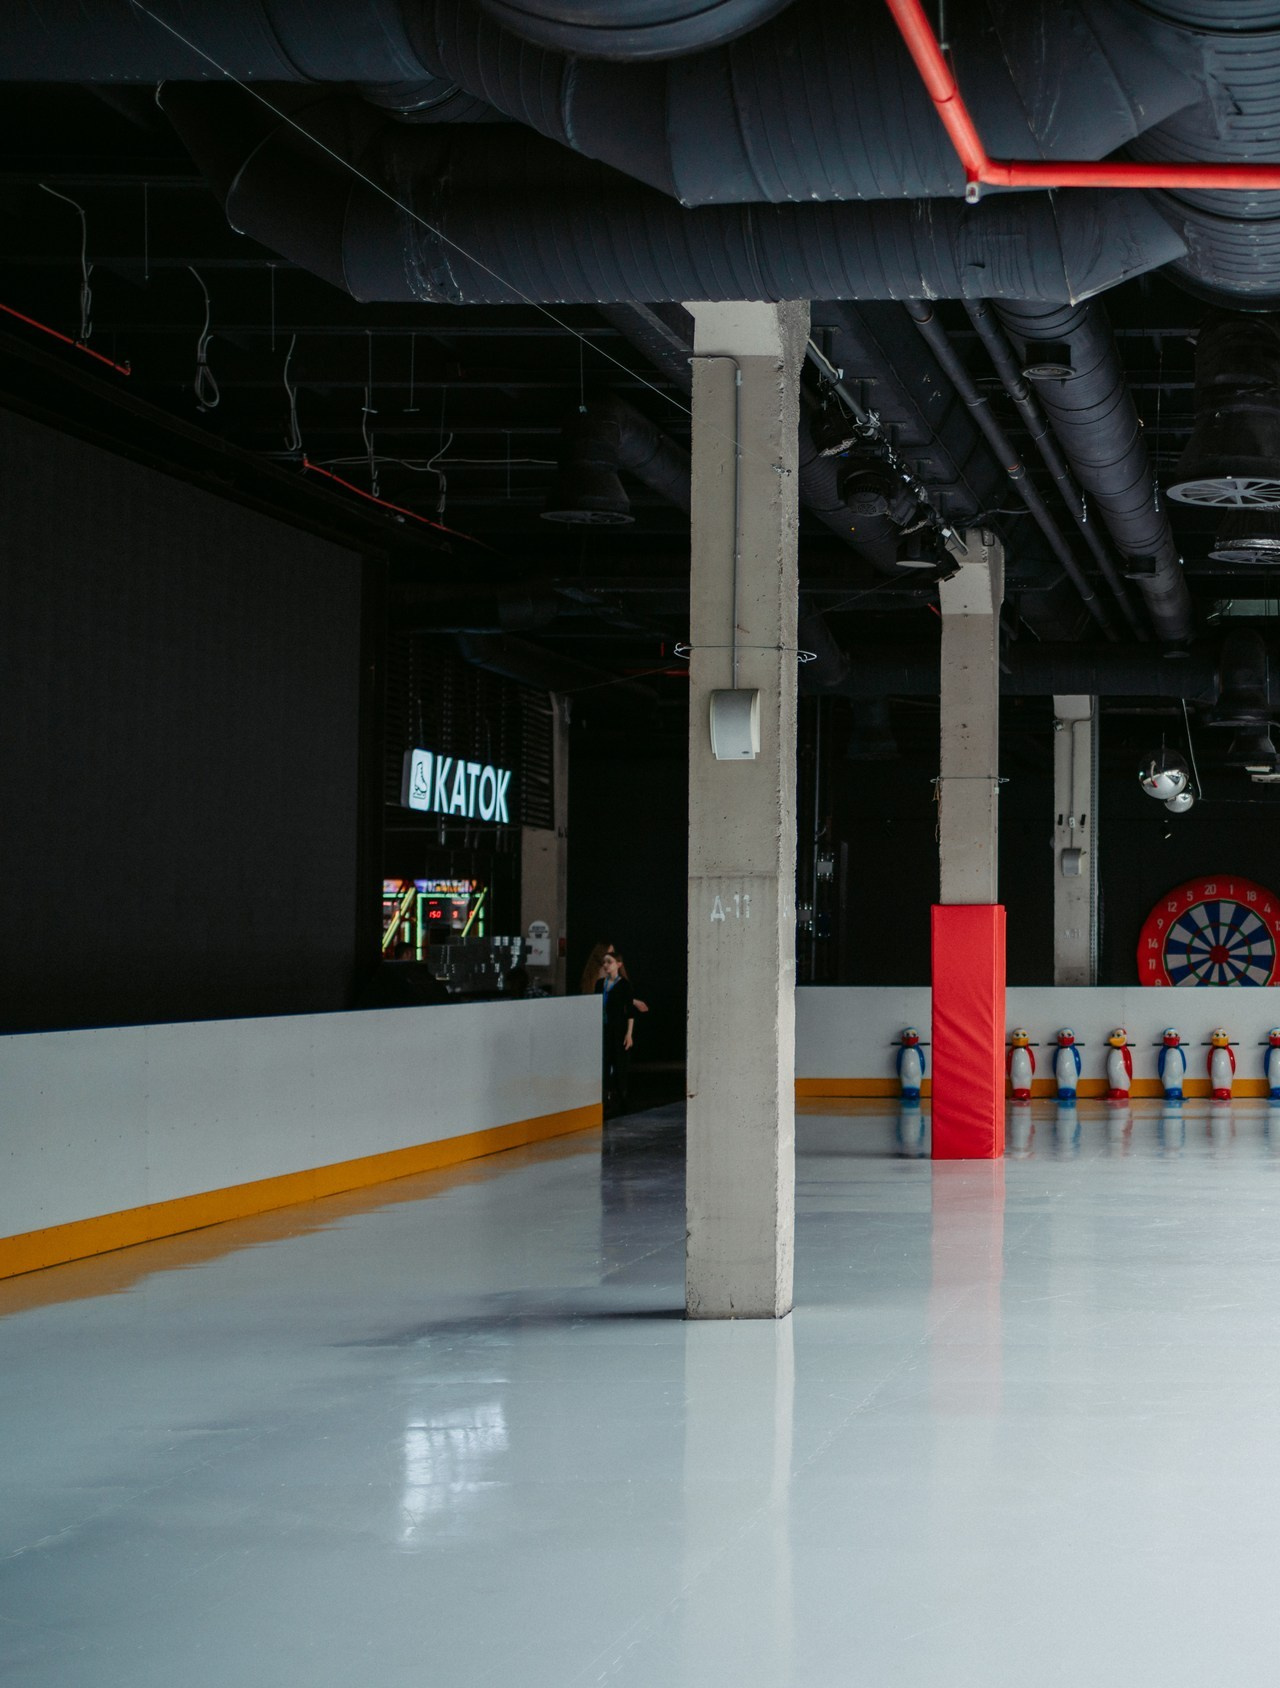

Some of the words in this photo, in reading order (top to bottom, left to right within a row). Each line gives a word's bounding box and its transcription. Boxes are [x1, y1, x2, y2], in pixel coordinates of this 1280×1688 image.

[1204, 884, 1217, 895] 20
[1229, 884, 1234, 895] 1
[1186, 891, 1194, 901] 5
[1246, 891, 1257, 901] 18
[1167, 901, 1178, 912] 12
[1263, 903, 1271, 914] 4
[1156, 918, 1164, 929] 9
[1148, 938, 1159, 949] 14
[1148, 958, 1156, 970] 11
